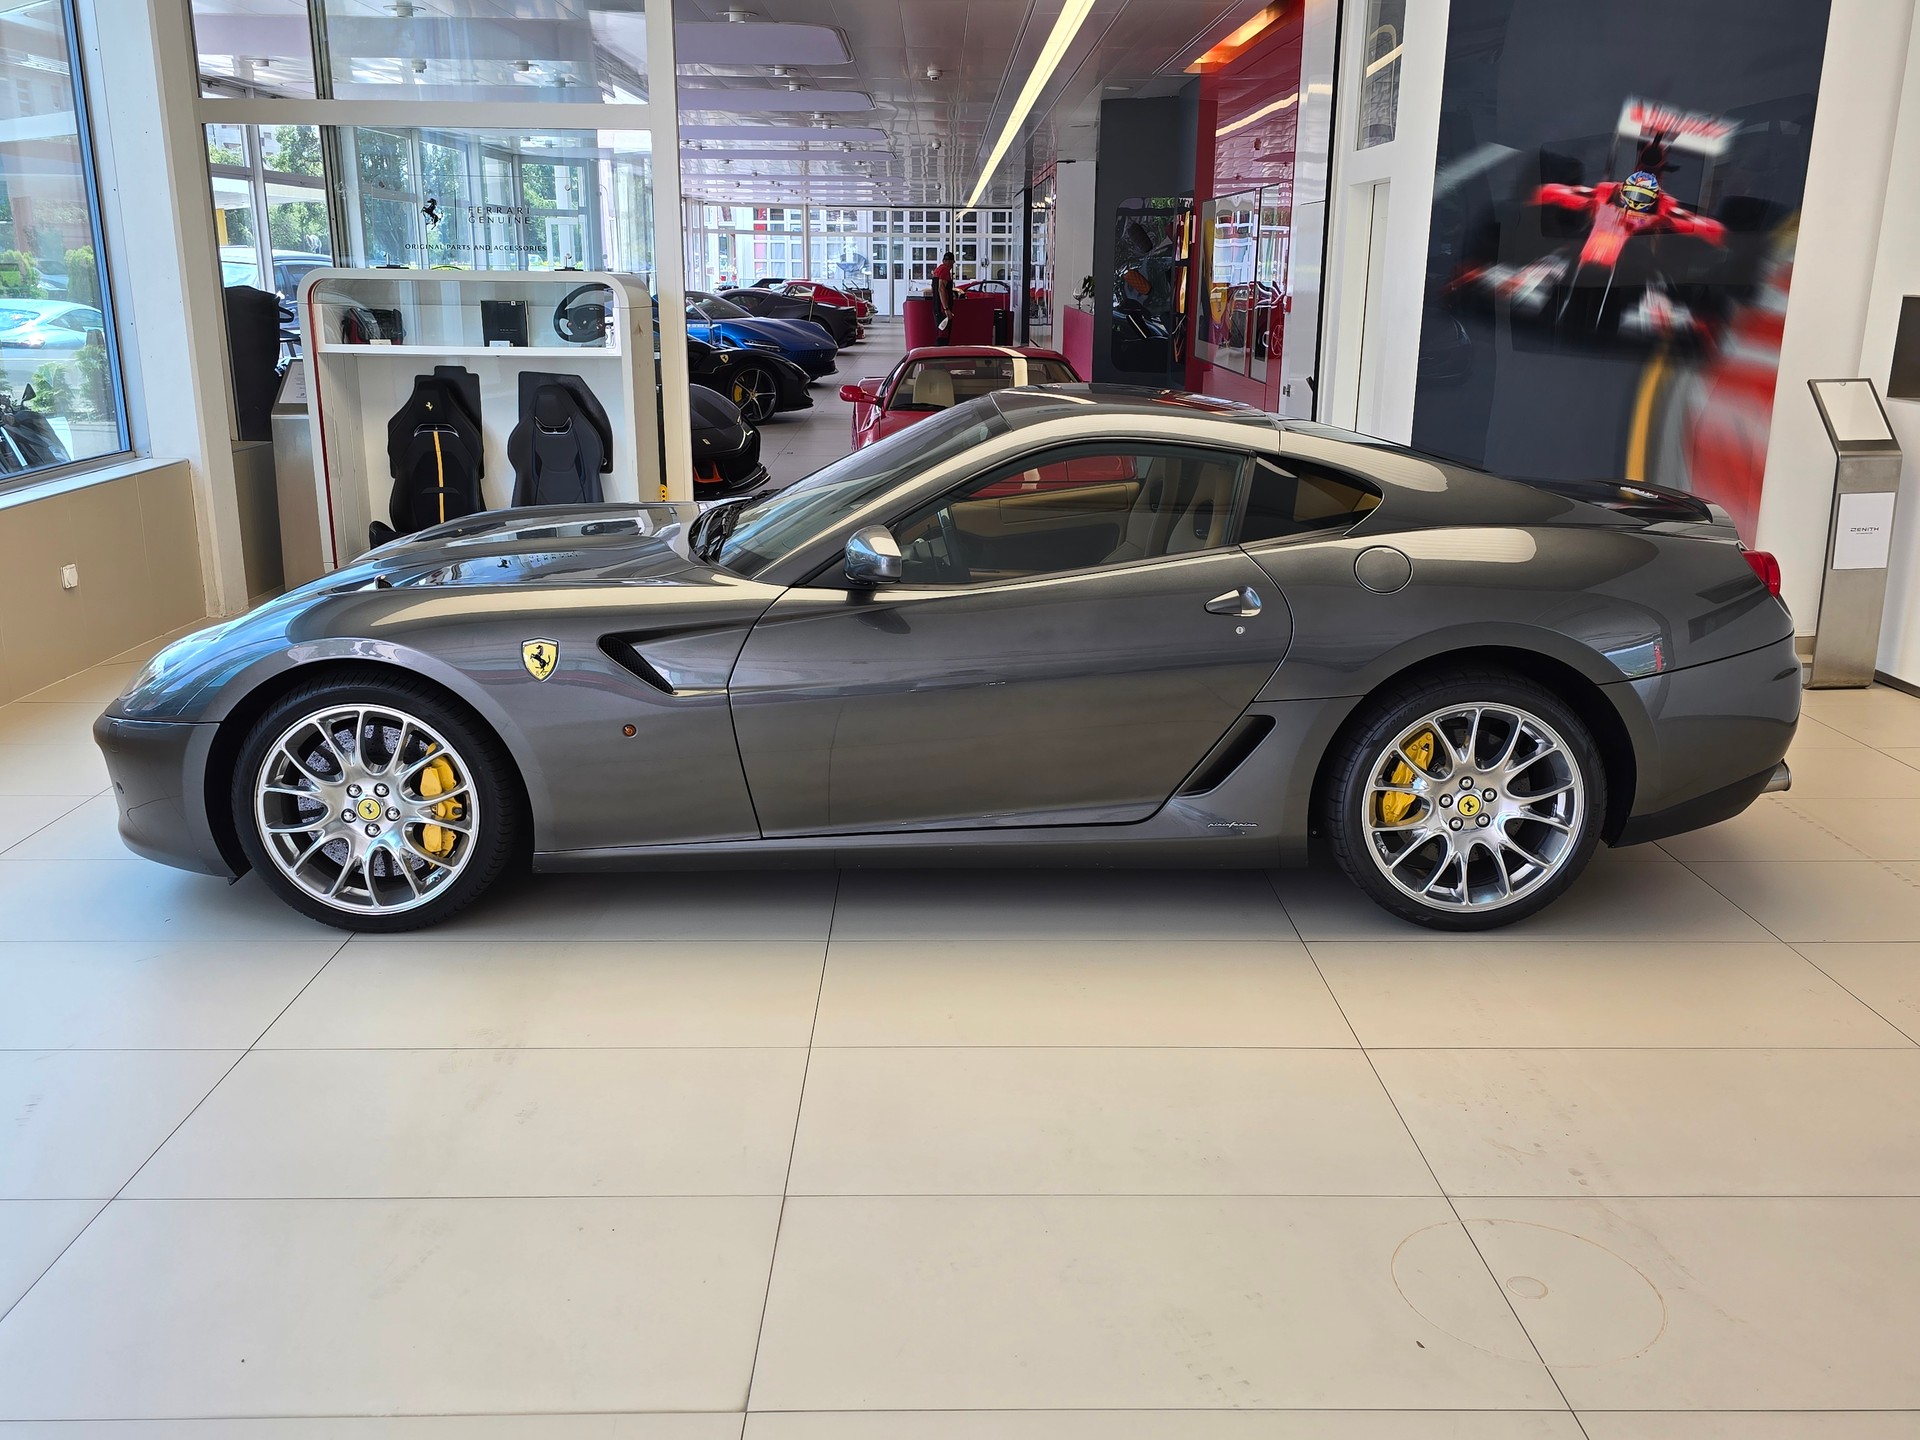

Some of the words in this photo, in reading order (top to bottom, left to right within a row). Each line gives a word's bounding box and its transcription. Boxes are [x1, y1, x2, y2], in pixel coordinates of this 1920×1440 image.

[468, 206, 530, 215] FERRARI
[468, 215, 531, 224] GENUINE
[404, 243, 444, 251] ORIGINAL
[446, 243, 471, 251] PARTS
[473, 244, 491, 252] AND
[494, 244, 546, 252] ACCESSORIES
